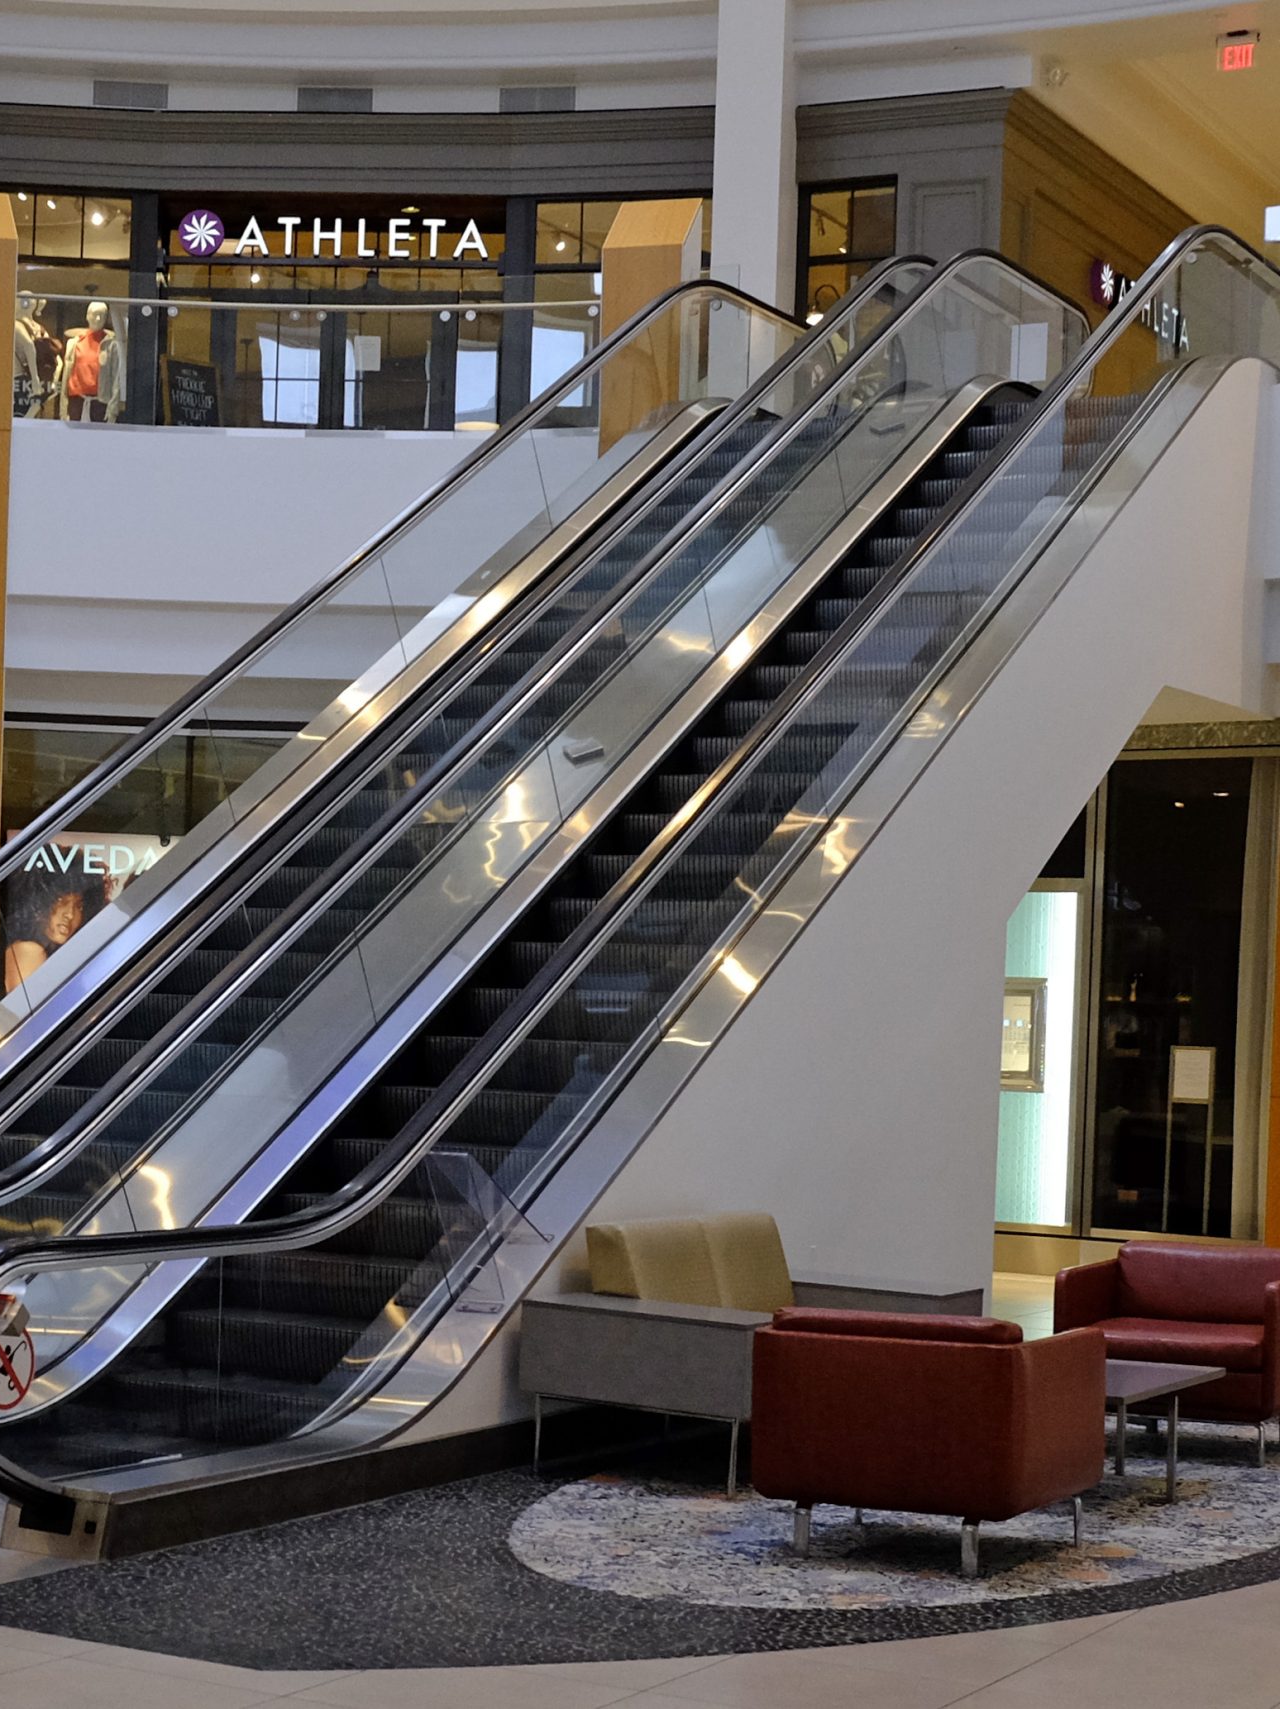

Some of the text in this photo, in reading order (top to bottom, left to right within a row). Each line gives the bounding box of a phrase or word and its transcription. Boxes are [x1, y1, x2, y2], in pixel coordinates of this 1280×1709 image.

[1223, 44, 1255, 70] EXIT
[234, 215, 489, 259] ATHLETA
[1119, 277, 1190, 352] AHLETA
